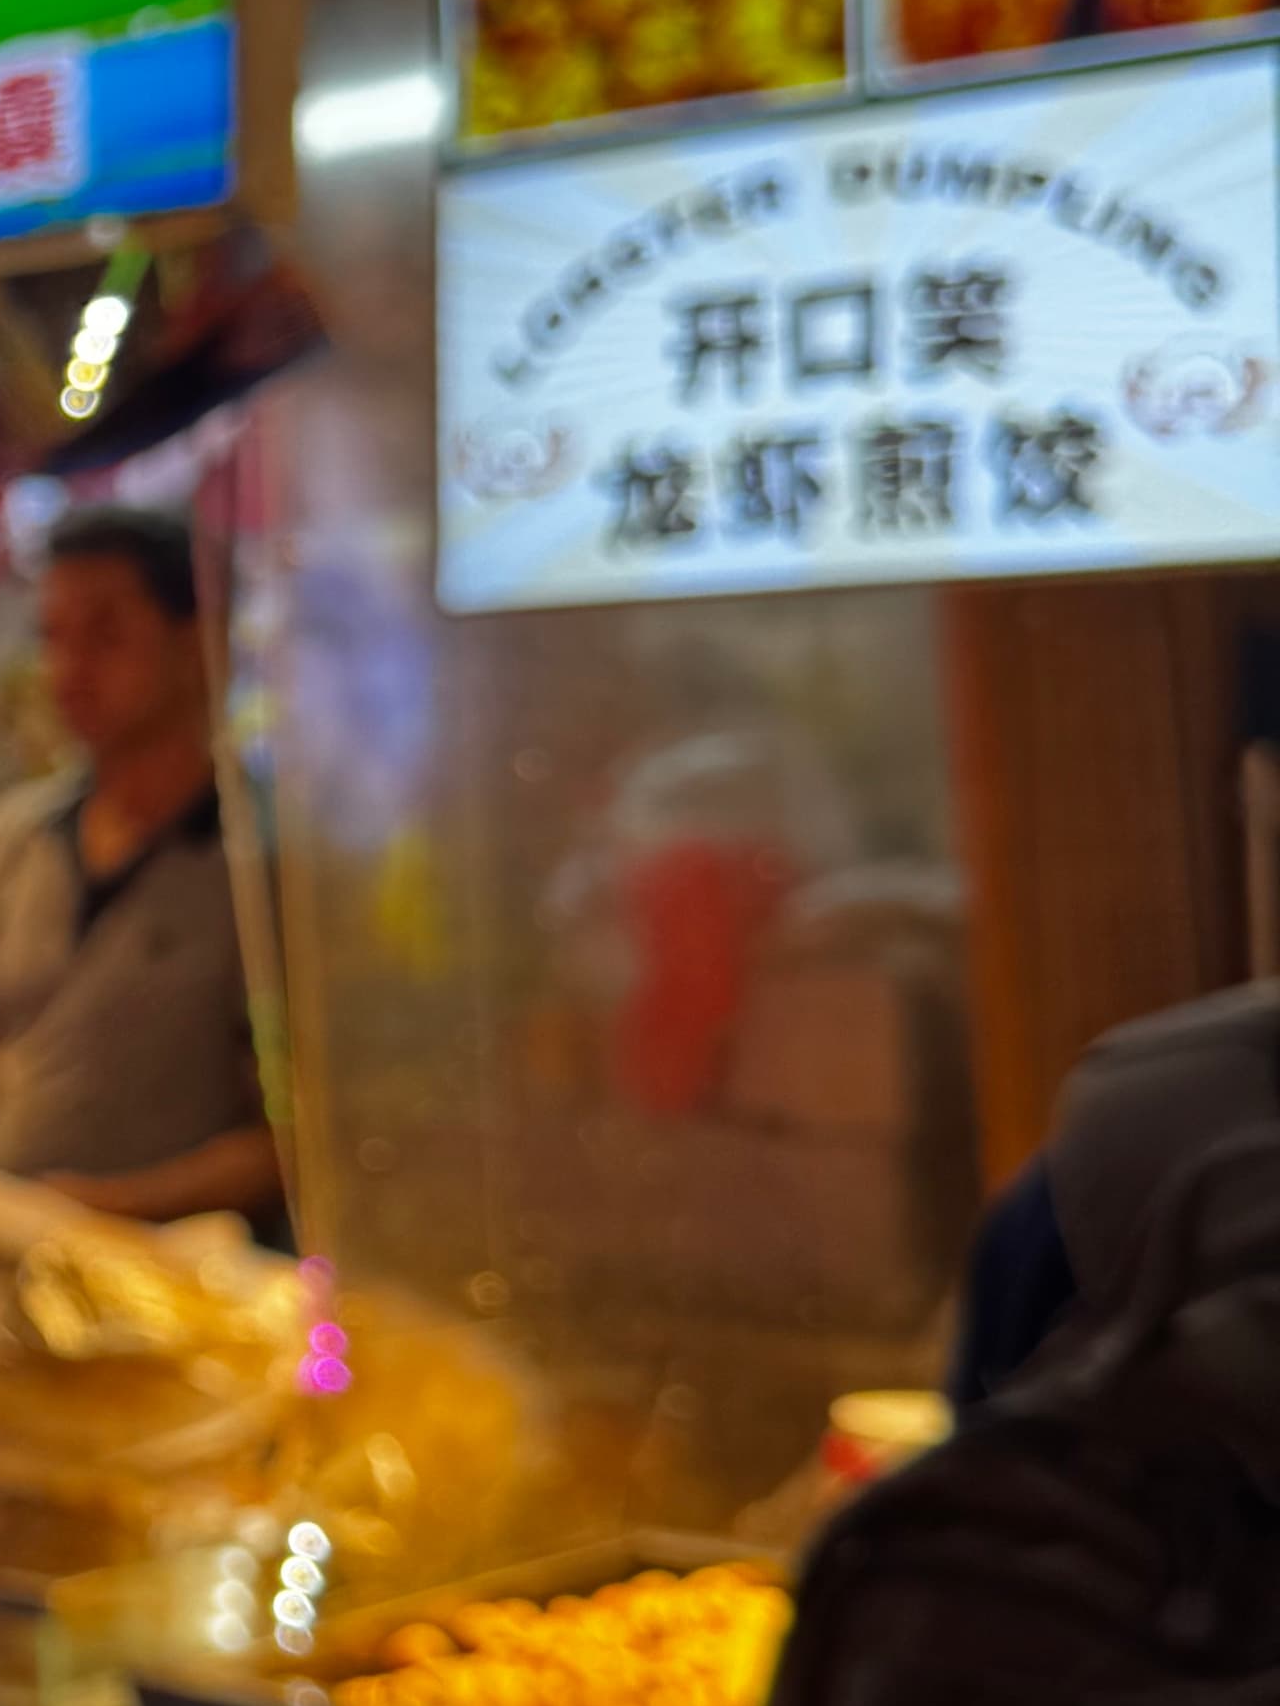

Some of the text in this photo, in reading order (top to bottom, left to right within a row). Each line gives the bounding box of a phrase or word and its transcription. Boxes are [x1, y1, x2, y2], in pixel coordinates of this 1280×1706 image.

[828, 148, 1225, 310] DUMPLING
[670, 265, 1010, 401] 开口笑
